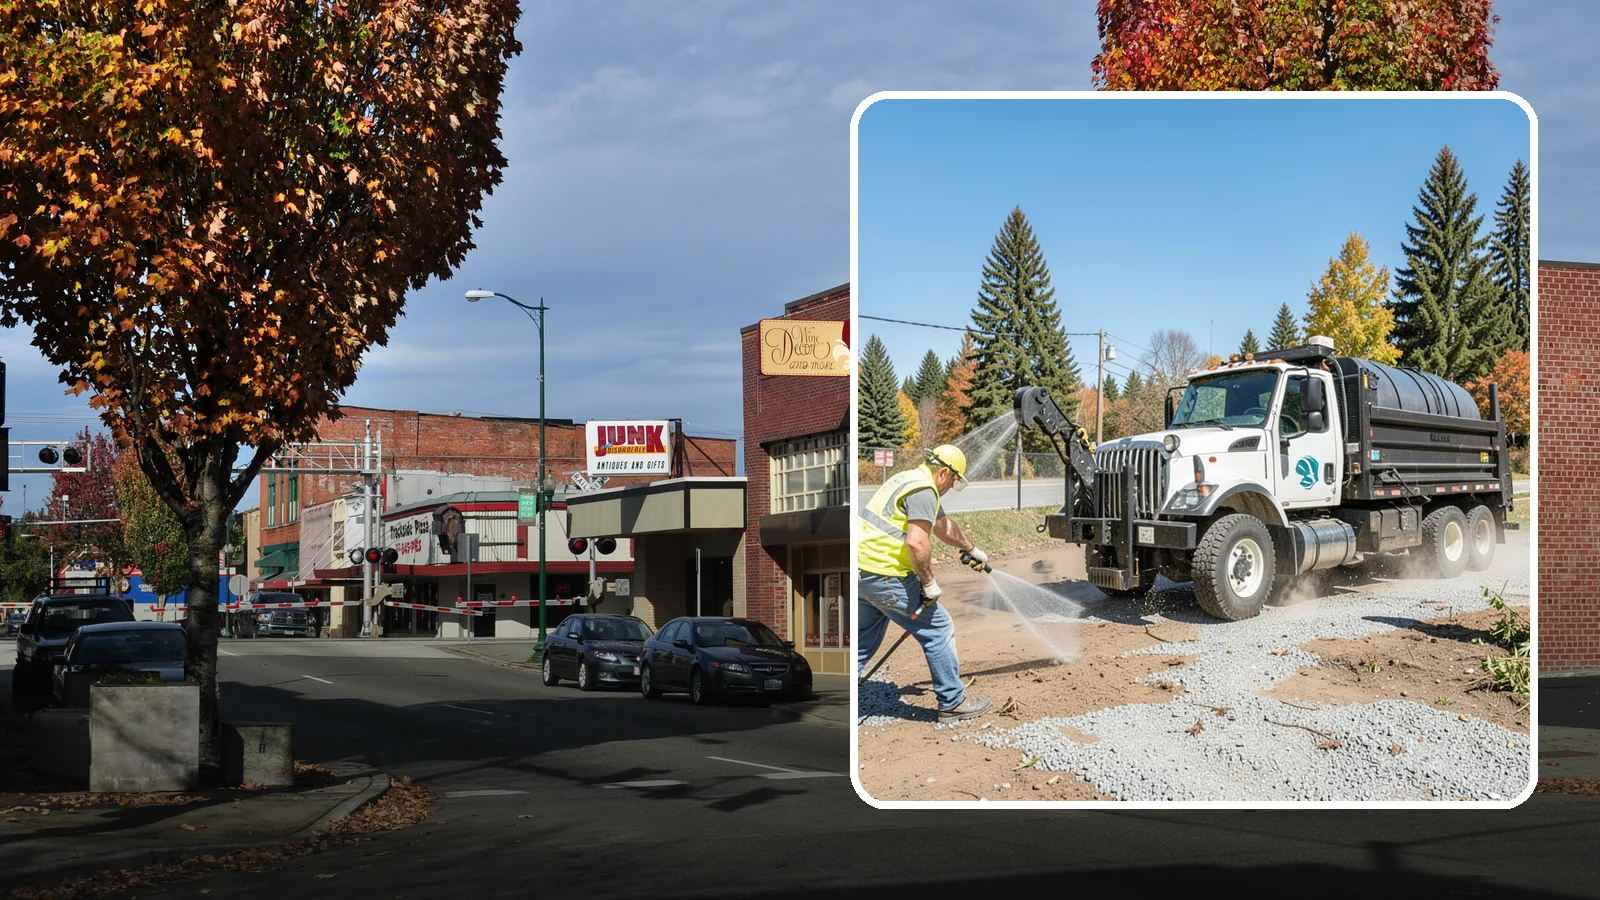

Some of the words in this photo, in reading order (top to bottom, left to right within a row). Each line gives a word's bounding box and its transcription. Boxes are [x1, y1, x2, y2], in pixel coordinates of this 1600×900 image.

[595, 425, 664, 457] JUNK
[607, 446, 646, 454] DISORDERLY
[597, 461, 628, 470] ANTIQUES
[631, 461, 644, 470] AND
[647, 460, 665, 469] GIFTS
[390, 521, 412, 540] Trackside
[414, 519, 429, 535] Pizza
